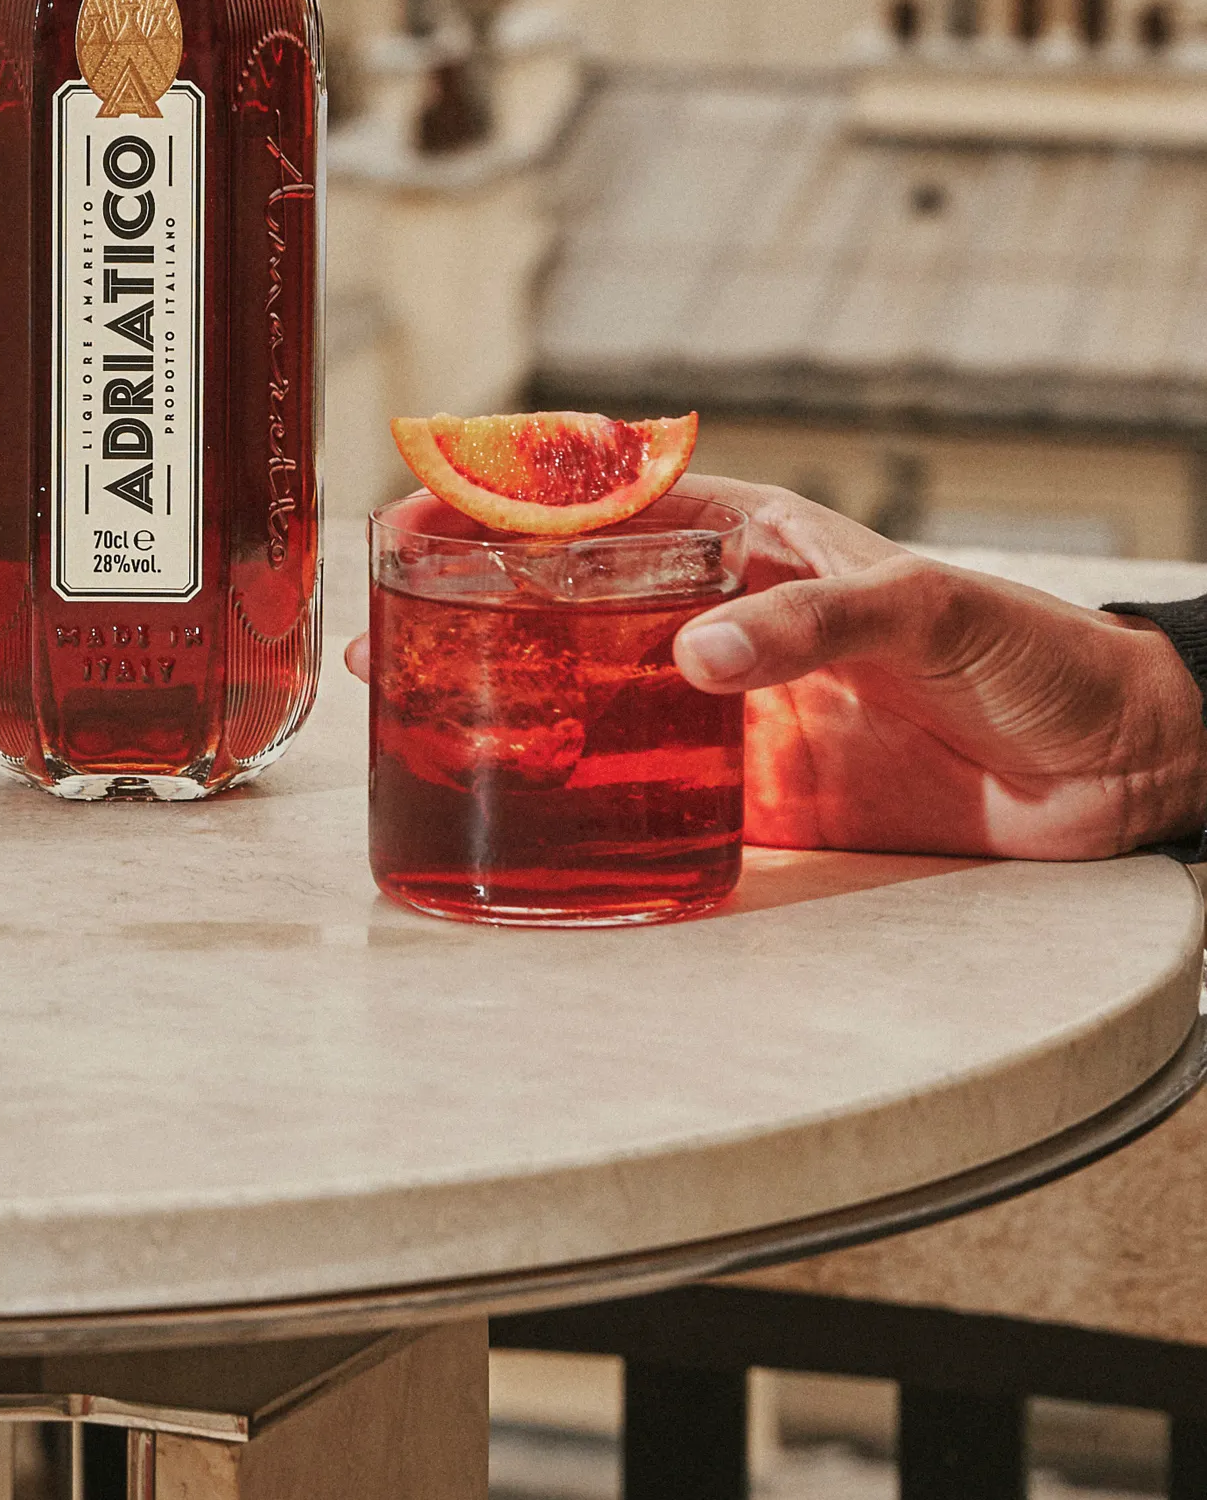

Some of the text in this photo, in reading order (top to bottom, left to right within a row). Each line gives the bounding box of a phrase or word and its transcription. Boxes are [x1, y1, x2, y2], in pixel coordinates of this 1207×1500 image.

[82, 202, 94, 449] LIQUORE AMARETTO
[102, 135, 156, 515] ADRIATICO
[164, 217, 176, 434] PRODOTTO ITALIANO
[93, 529, 130, 550] 70cl
[93, 554, 162, 574] 28%vol.
[56, 625, 203, 648] MADE IN
[83, 656, 176, 684] ITALY
